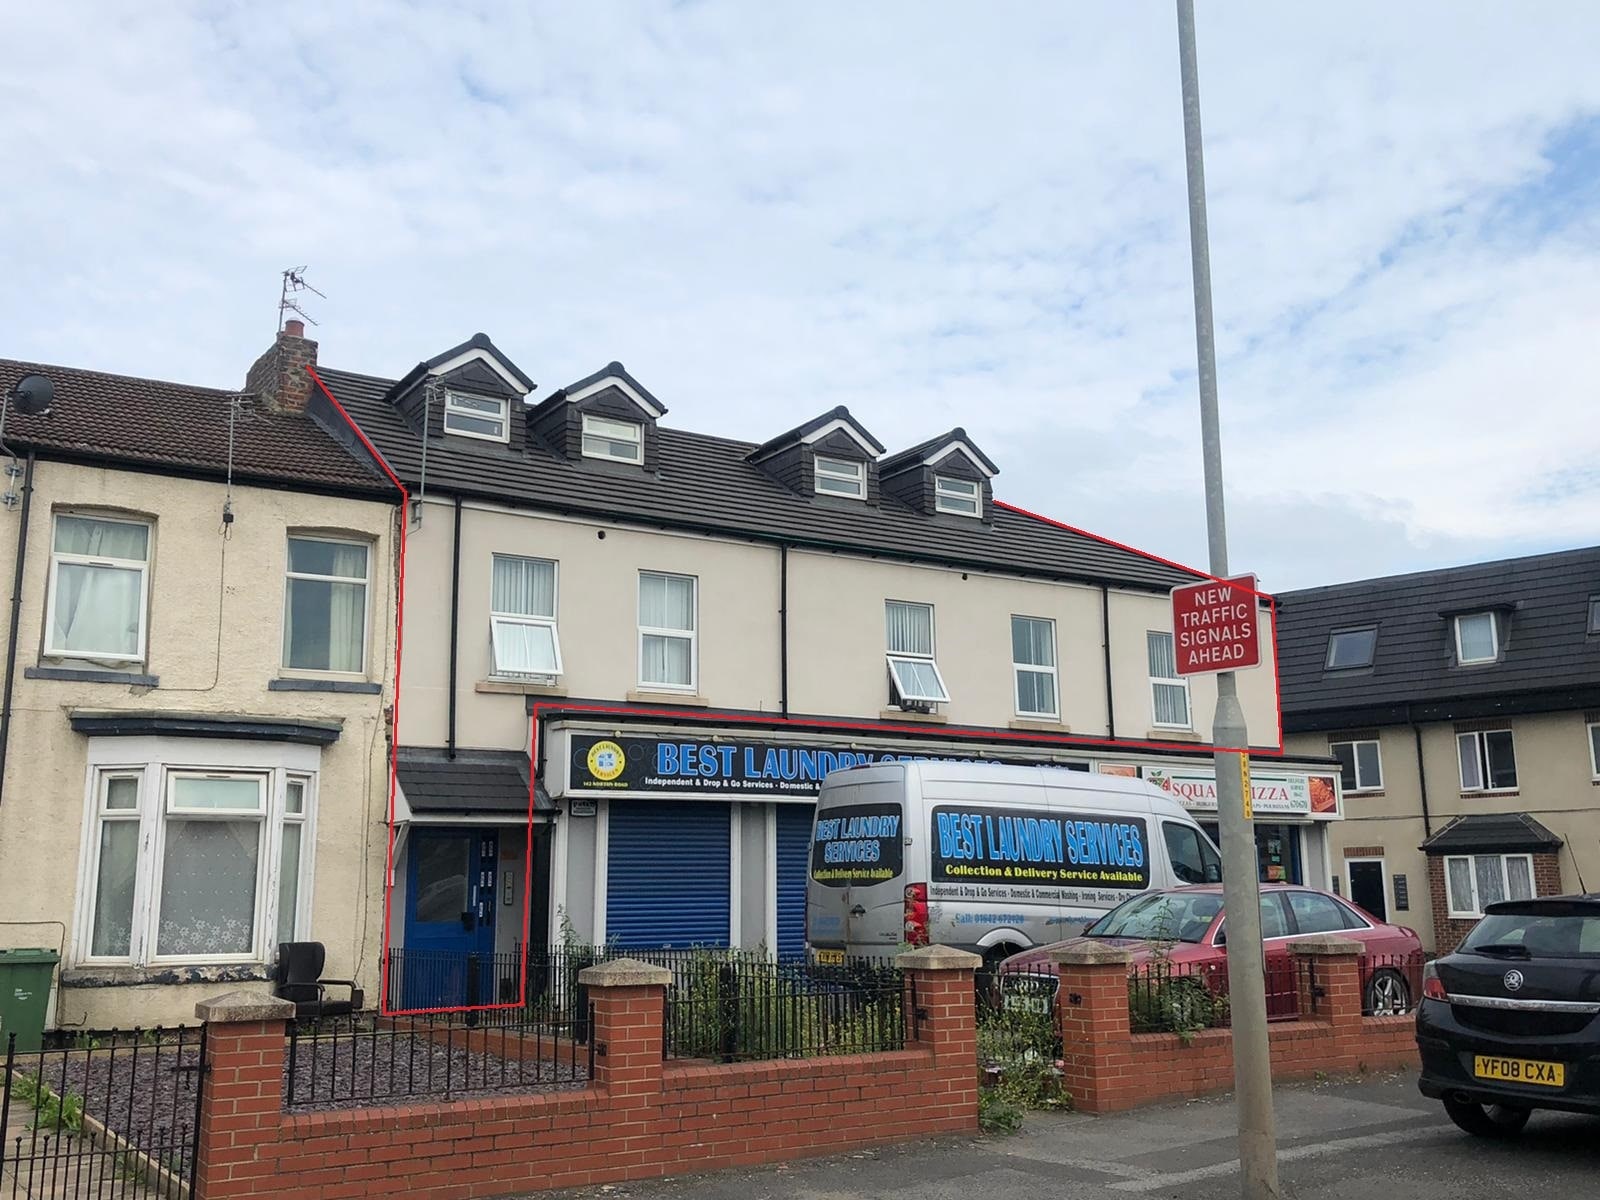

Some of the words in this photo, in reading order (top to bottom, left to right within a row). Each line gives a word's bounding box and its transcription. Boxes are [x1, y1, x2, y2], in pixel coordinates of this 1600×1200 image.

[1195, 587, 1232, 607] NEW
[1181, 604, 1248, 628] TRAFFIC
[1180, 623, 1252, 647] SIGNALS
[1189, 644, 1245, 666] AHEAD
[657, 743, 736, 777] BEST
[645, 777, 693, 787] Independent
[703, 779, 721, 788] Drop
[743, 781, 774, 789] Services
[780, 782, 814, 790] Domestic
[1173, 783, 1216, 801] SQUA
[1252, 786, 1288, 800] IZZA
[816, 819, 840, 841] BEST
[842, 815, 900, 838] LAUNDRY
[824, 840, 880, 862] SERVICES
[937, 813, 983, 859] BEST
[986, 815, 1063, 862] LAUNDRY
[1065, 820, 1143, 867] SERVICES
[945, 864, 1002, 877] Collection
[1004, 868, 1011, 877] &
[1014, 868, 1058, 880] Delivery
[1060, 869, 1098, 880] Service
[1100, 871, 1143, 882] Available
[930, 886, 959, 897] Independent
[965, 887, 975, 897] Drop
[988, 888, 1007, 898] Services
[1010, 889, 1030, 898] Domestic
[1482, 1058, 1520, 1078] YF08
[1524, 1063, 1556, 1082] CXA
